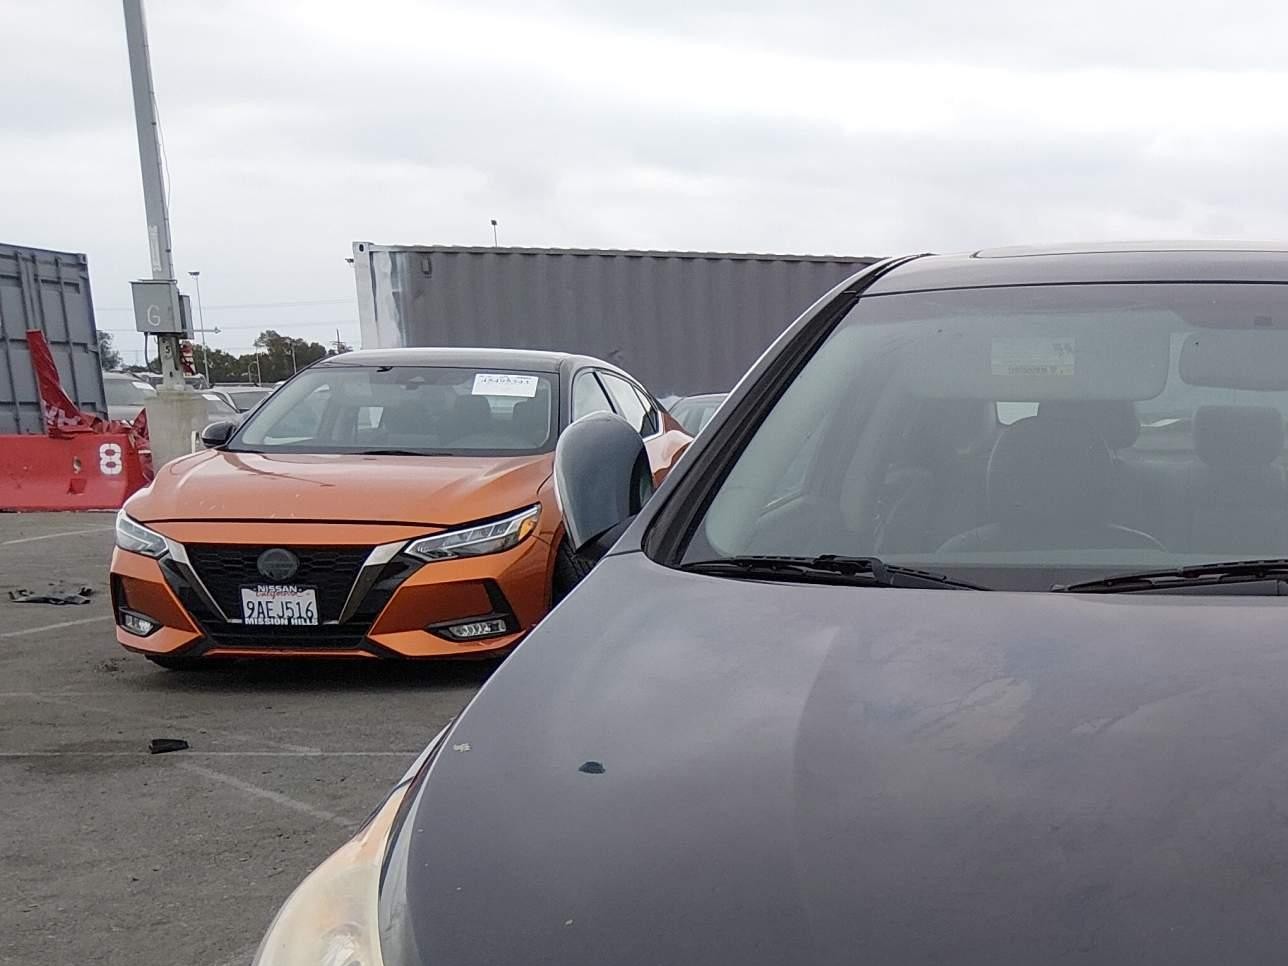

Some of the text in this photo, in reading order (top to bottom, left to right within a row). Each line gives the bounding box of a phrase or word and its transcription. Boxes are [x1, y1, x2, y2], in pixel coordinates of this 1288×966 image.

[147, 304, 161, 326] G
[99, 443, 123, 475] 8
[246, 600, 315, 619] 9AEJ516
[244, 617, 318, 625] MISSION HILLS
